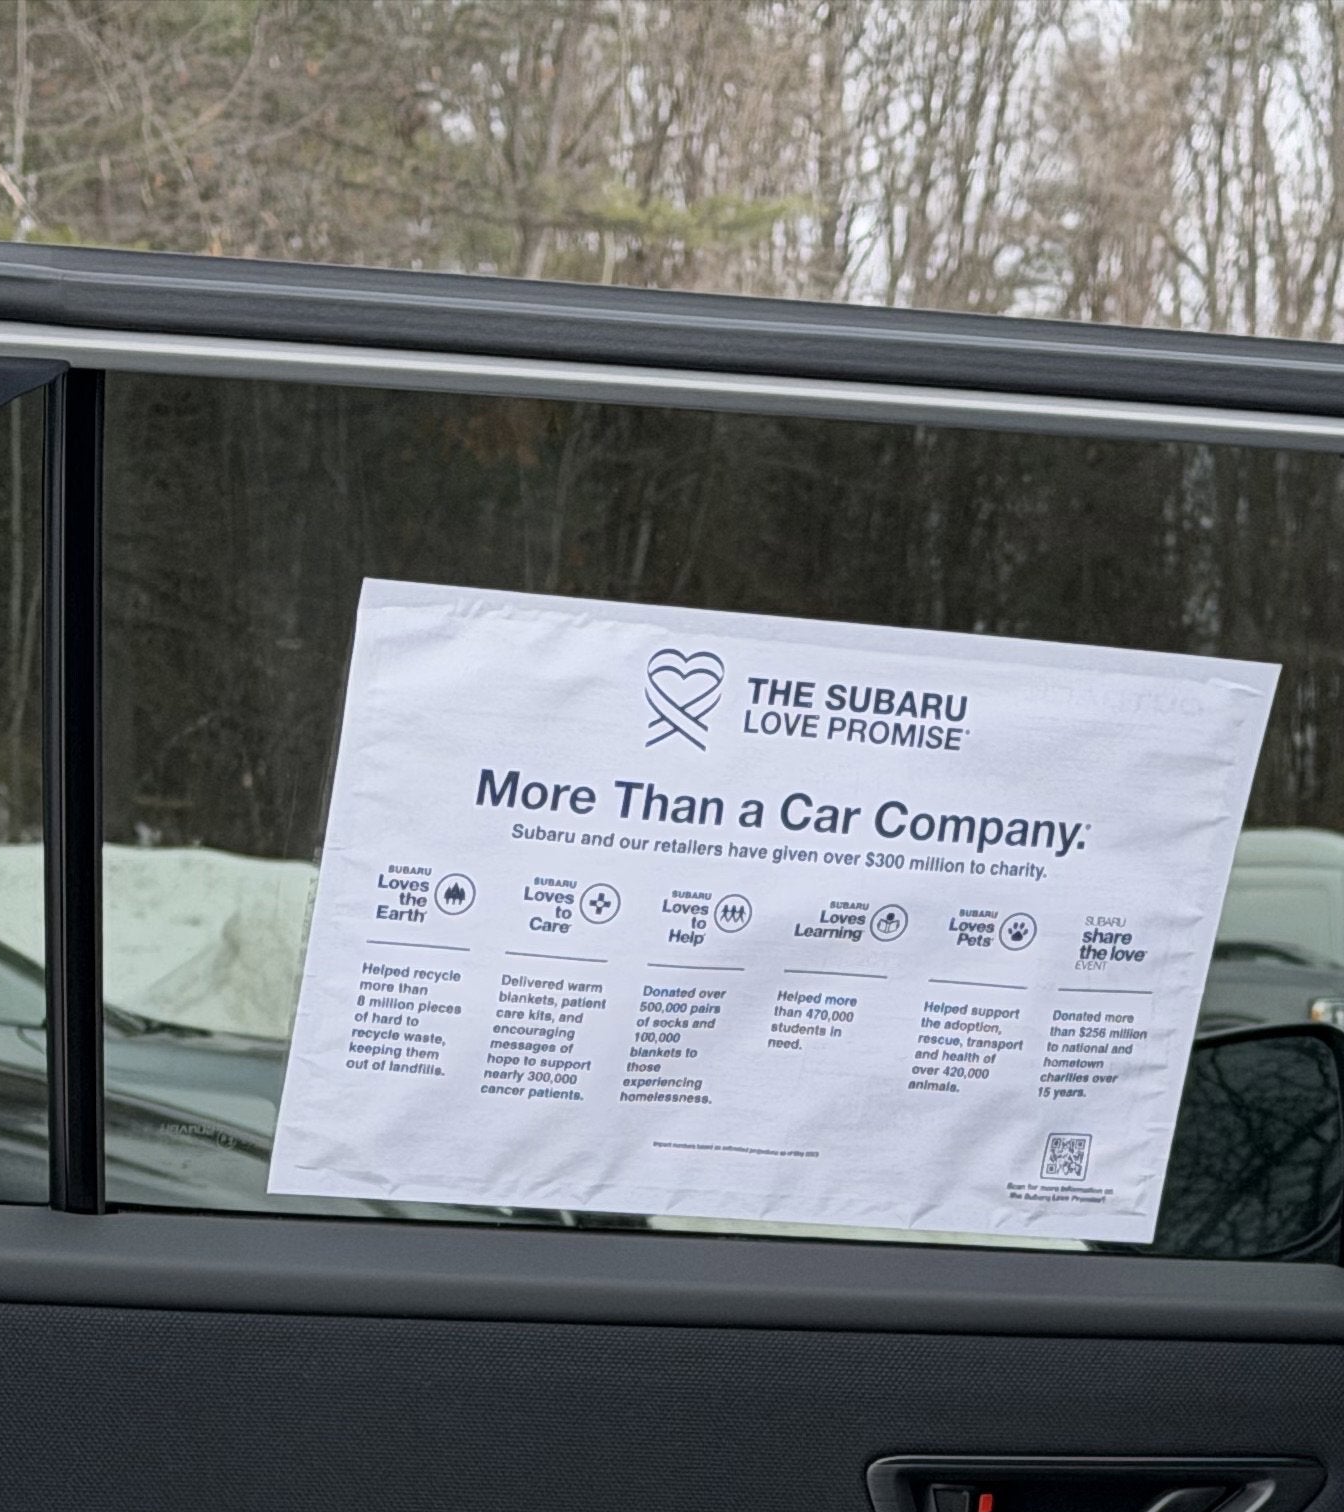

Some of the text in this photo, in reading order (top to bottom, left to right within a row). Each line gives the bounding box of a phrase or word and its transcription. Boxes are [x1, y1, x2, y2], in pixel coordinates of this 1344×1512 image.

[747, 676, 967, 721] THE SUBARU
[743, 709, 820, 738] LOVE
[475, 768, 596, 814] More
[614, 780, 723, 825] Than
[738, 799, 764, 828] a
[780, 792, 861, 834] Car
[511, 823, 1047, 881] Subaru and our retailers have given over $300 million to charity.
[387, 864, 432, 876] SUBARU
[377, 873, 429, 892] Loves
[533, 876, 577, 889] SUBARU
[398, 891, 427, 907] the
[523, 885, 574, 904] Loves
[671, 889, 712, 900] SUBARU
[555, 905, 572, 919] to
[661, 898, 709, 915] Loves
[829, 900, 869, 910] SUBARU
[819, 909, 866, 925] Loves
[958, 908, 998, 918] SUBARU
[691, 916, 706, 929] to
[948, 916, 995, 933] Loves
[1084, 915, 1126, 927] SUBARU
[1081, 927, 1132, 945] share
[1079, 944, 1107, 960] the
[361, 961, 461, 983] Helped recycle
[1074, 959, 1105, 970] EVENT
[359, 980, 428, 995] more than
[501, 973, 602, 993] Delivered warm
[642, 984, 727, 999] Donated over
[776, 989, 857, 1007] Helped more
[356, 994, 461, 1014] 8 million pieces
[498, 990, 606, 1009] blankets, patient
[495, 1008, 583, 1023] care kits, and
[639, 1001, 720, 1015] 500,000 pairs
[773, 1005, 854, 1022] than 470,000
[923, 1000, 1020, 1019] Helped support
[354, 1011, 419, 1026] of hard to
[636, 1016, 716, 1028] of socks and
[1052, 1009, 1134, 1023] Donated more
[492, 1024, 575, 1041] encouraging
[770, 1022, 842, 1037] students in
[920, 1016, 1001, 1035] the adoption,
[1049, 1026, 1075, 1036] than
[1108, 1028, 1148, 1040] million
[351, 1028, 446, 1046] recycle waste,
[634, 1031, 680, 1043] 100,000
[767, 1038, 802, 1050] need.
[917, 1034, 1023, 1051] rescue, transport
[348, 1041, 439, 1060] keeping them
[489, 1039, 574, 1054] messages of
[629, 1046, 697, 1058] blankets to
[1046, 1041, 1133, 1054] to national and
[486, 1052, 591, 1071] hope to support
[914, 1049, 996, 1063] and health of
[1042, 1056, 1104, 1068] hometown
[345, 1058, 445, 1076] out of landfills.
[626, 1061, 661, 1072] those
[911, 1065, 989, 1079] over 420,000
[483, 1069, 577, 1084] nearly 300,000
[622, 1076, 702, 1090] experiencing
[1039, 1071, 1119, 1083] charities over
[480, 1084, 583, 1100] cancer patients.
[907, 1079, 959, 1092] animals.
[1038, 1086, 1086, 1100] 15 years.
[619, 1090, 712, 1104] homelessness.
